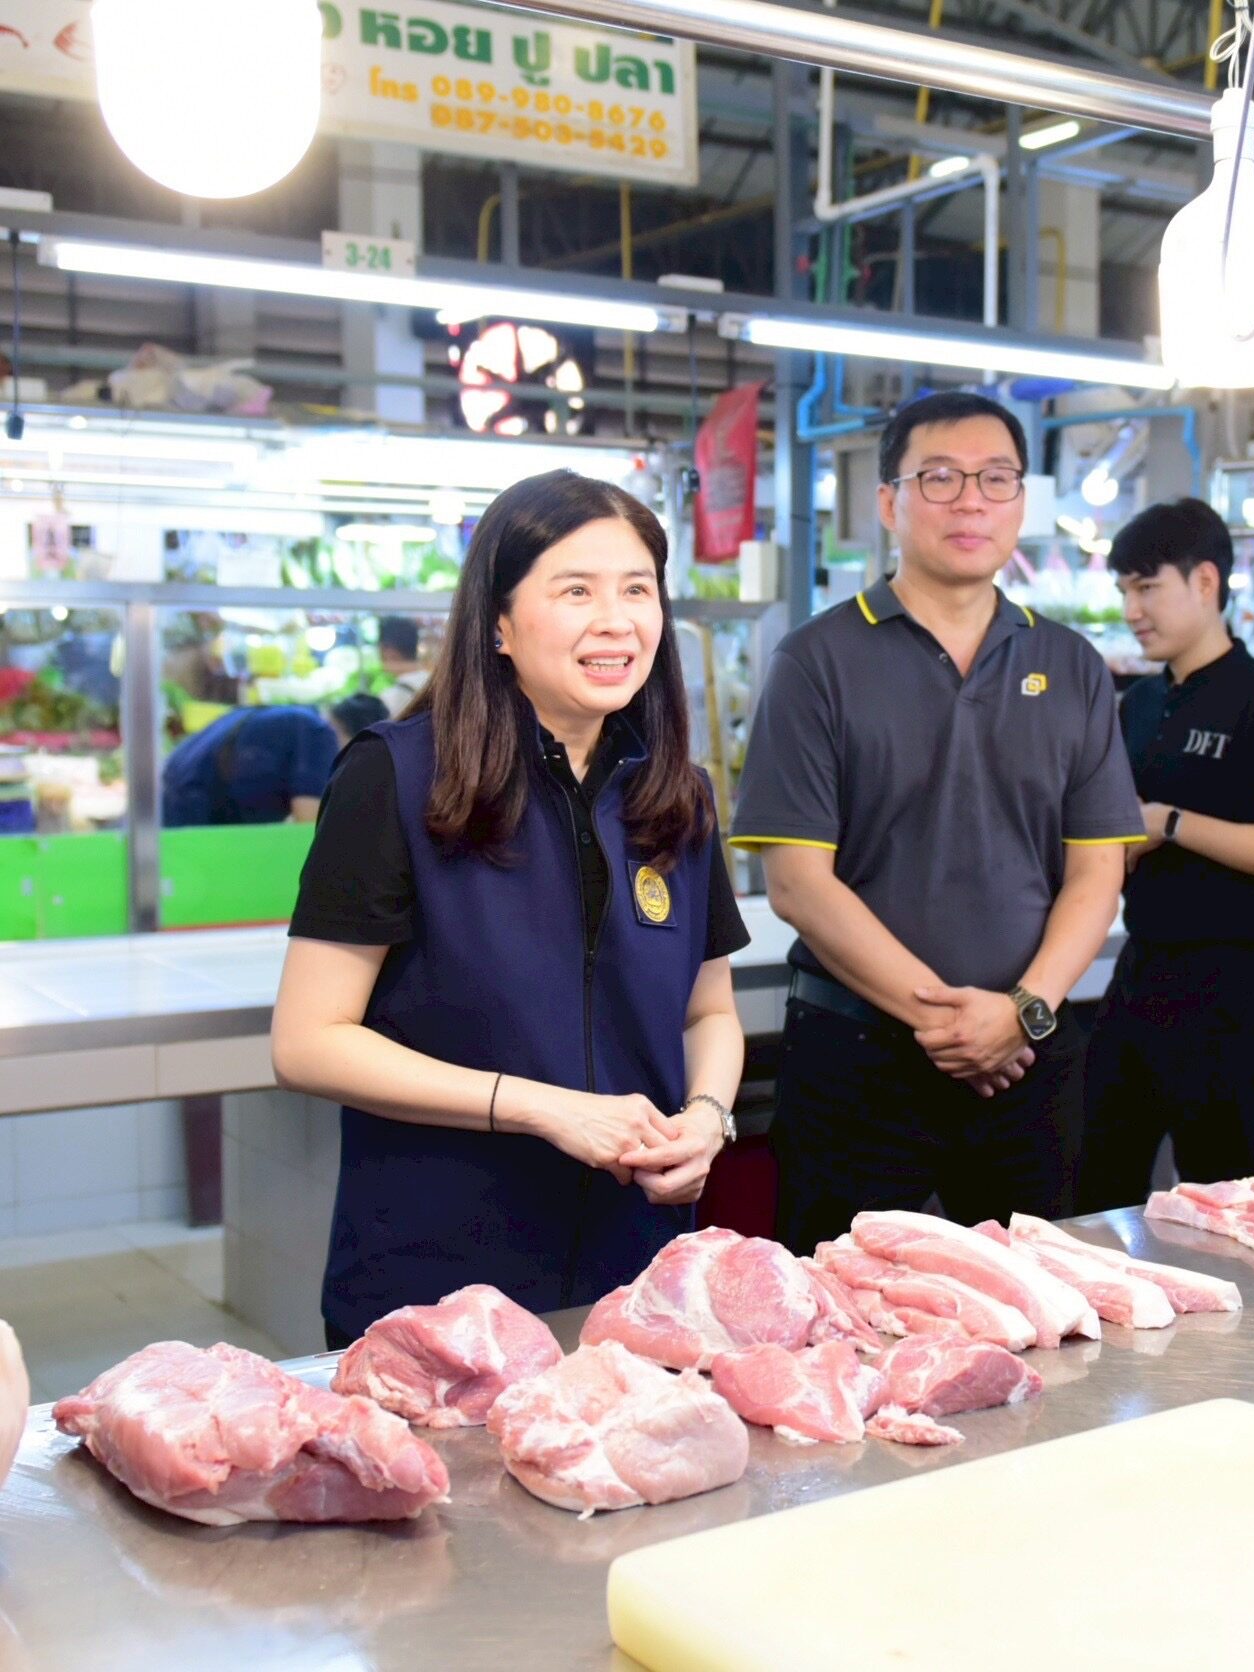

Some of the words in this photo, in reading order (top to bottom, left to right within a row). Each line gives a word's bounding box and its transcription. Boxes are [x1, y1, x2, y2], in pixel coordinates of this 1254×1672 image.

[359, 8, 493, 64] หอย
[511, 31, 551, 87] ปู
[574, 43, 675, 95] ปลา
[369, 65, 418, 104] โทร
[345, 242, 392, 271] 3-24
[1183, 728, 1232, 759] DFT
